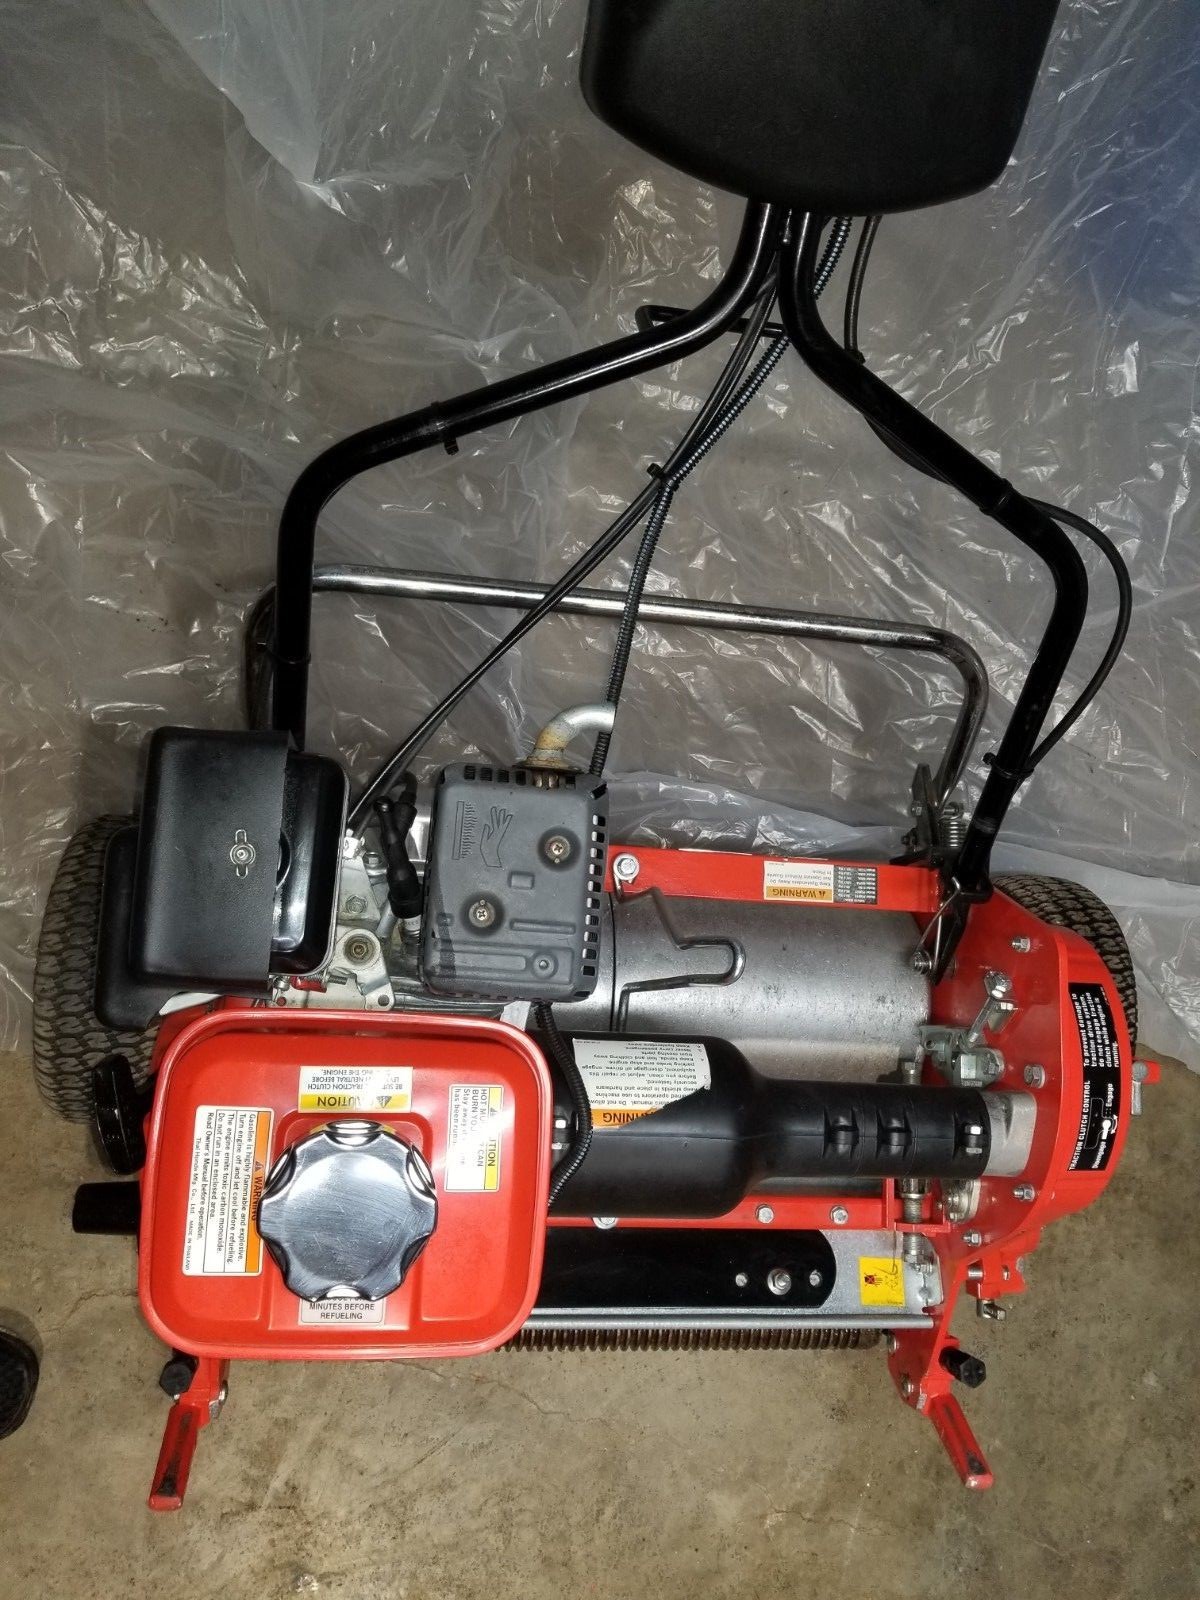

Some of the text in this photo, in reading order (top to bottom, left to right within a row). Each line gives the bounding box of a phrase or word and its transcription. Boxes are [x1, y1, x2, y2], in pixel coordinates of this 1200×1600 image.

[772, 889, 816, 898] WARNING
[1074, 1001, 1085, 1028] damage
[1085, 993, 1096, 1017] traction
[1097, 1005, 1106, 1025] engine
[1086, 1021, 1094, 1037] drive
[1093, 1019, 1102, 1043] engage
[1081, 1030, 1090, 1056] prevent
[1099, 1059, 1104, 1067] do
[317, 1096, 373, 1107] UTION
[462, 1089, 470, 1105] Stay
[471, 1090, 479, 1113] BURN
[1106, 1083, 1114, 1107] Engage
[218, 1113, 225, 1122] Do
[247, 1114, 256, 1142] Gasoline
[603, 1112, 655, 1123] NING
[224, 1128, 232, 1150] engine
[235, 1131, 243, 1153] engine
[1069, 1142, 1083, 1170] TRACTION
[1078, 1114, 1088, 1140] CLUTCH
[214, 1159, 219, 1167] an
[223, 1153, 231, 1171] emits
[242, 1152, 252, 1172] highly
[197, 1113, 214, 1240] Read Owner's Manual before operation.
[211, 1169, 219, 1199] enclosed
[221, 1173, 229, 1190] toxic
[241, 1175, 250, 1210] flammable
[220, 1192, 228, 1216] carbon
[229, 1209, 238, 1231] before
[216, 1218, 226, 1254] monoxide.
[237, 1228, 246, 1262] explosive.
[227, 1233, 235, 1264] refueling.
